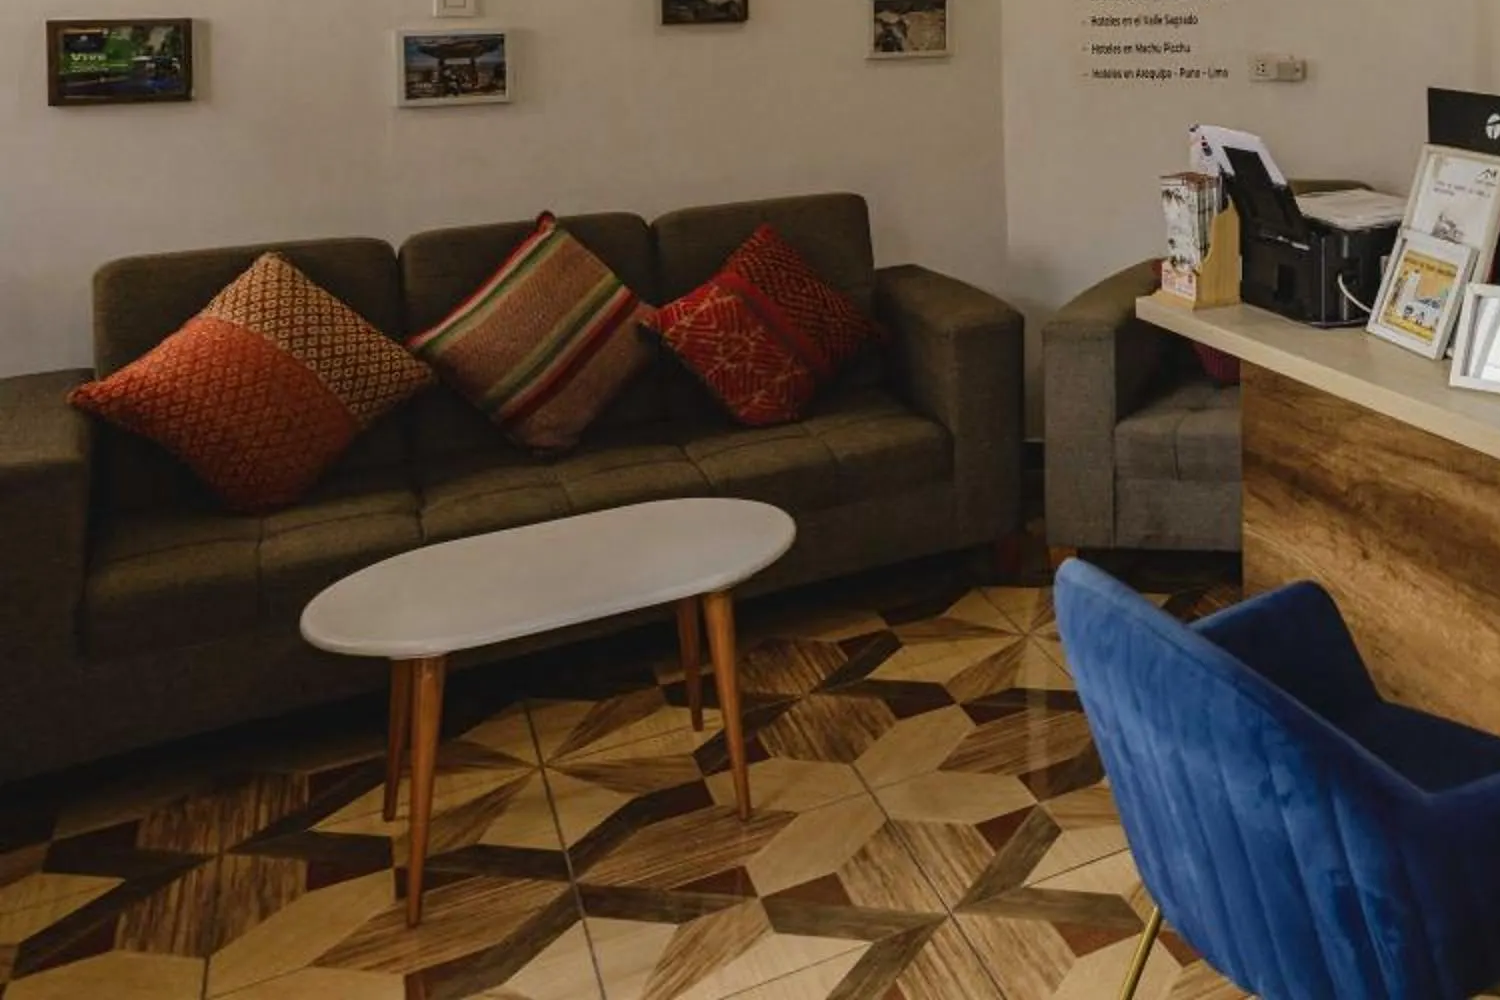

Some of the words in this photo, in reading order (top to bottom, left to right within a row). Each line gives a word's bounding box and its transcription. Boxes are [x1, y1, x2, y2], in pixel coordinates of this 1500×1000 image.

[1165, 13, 1199, 28] Sagrado
[1163, 41, 1192, 54] Picchu
[1135, 67, 1172, 81] Arequipa
[1207, 66, 1230, 79] Lima
